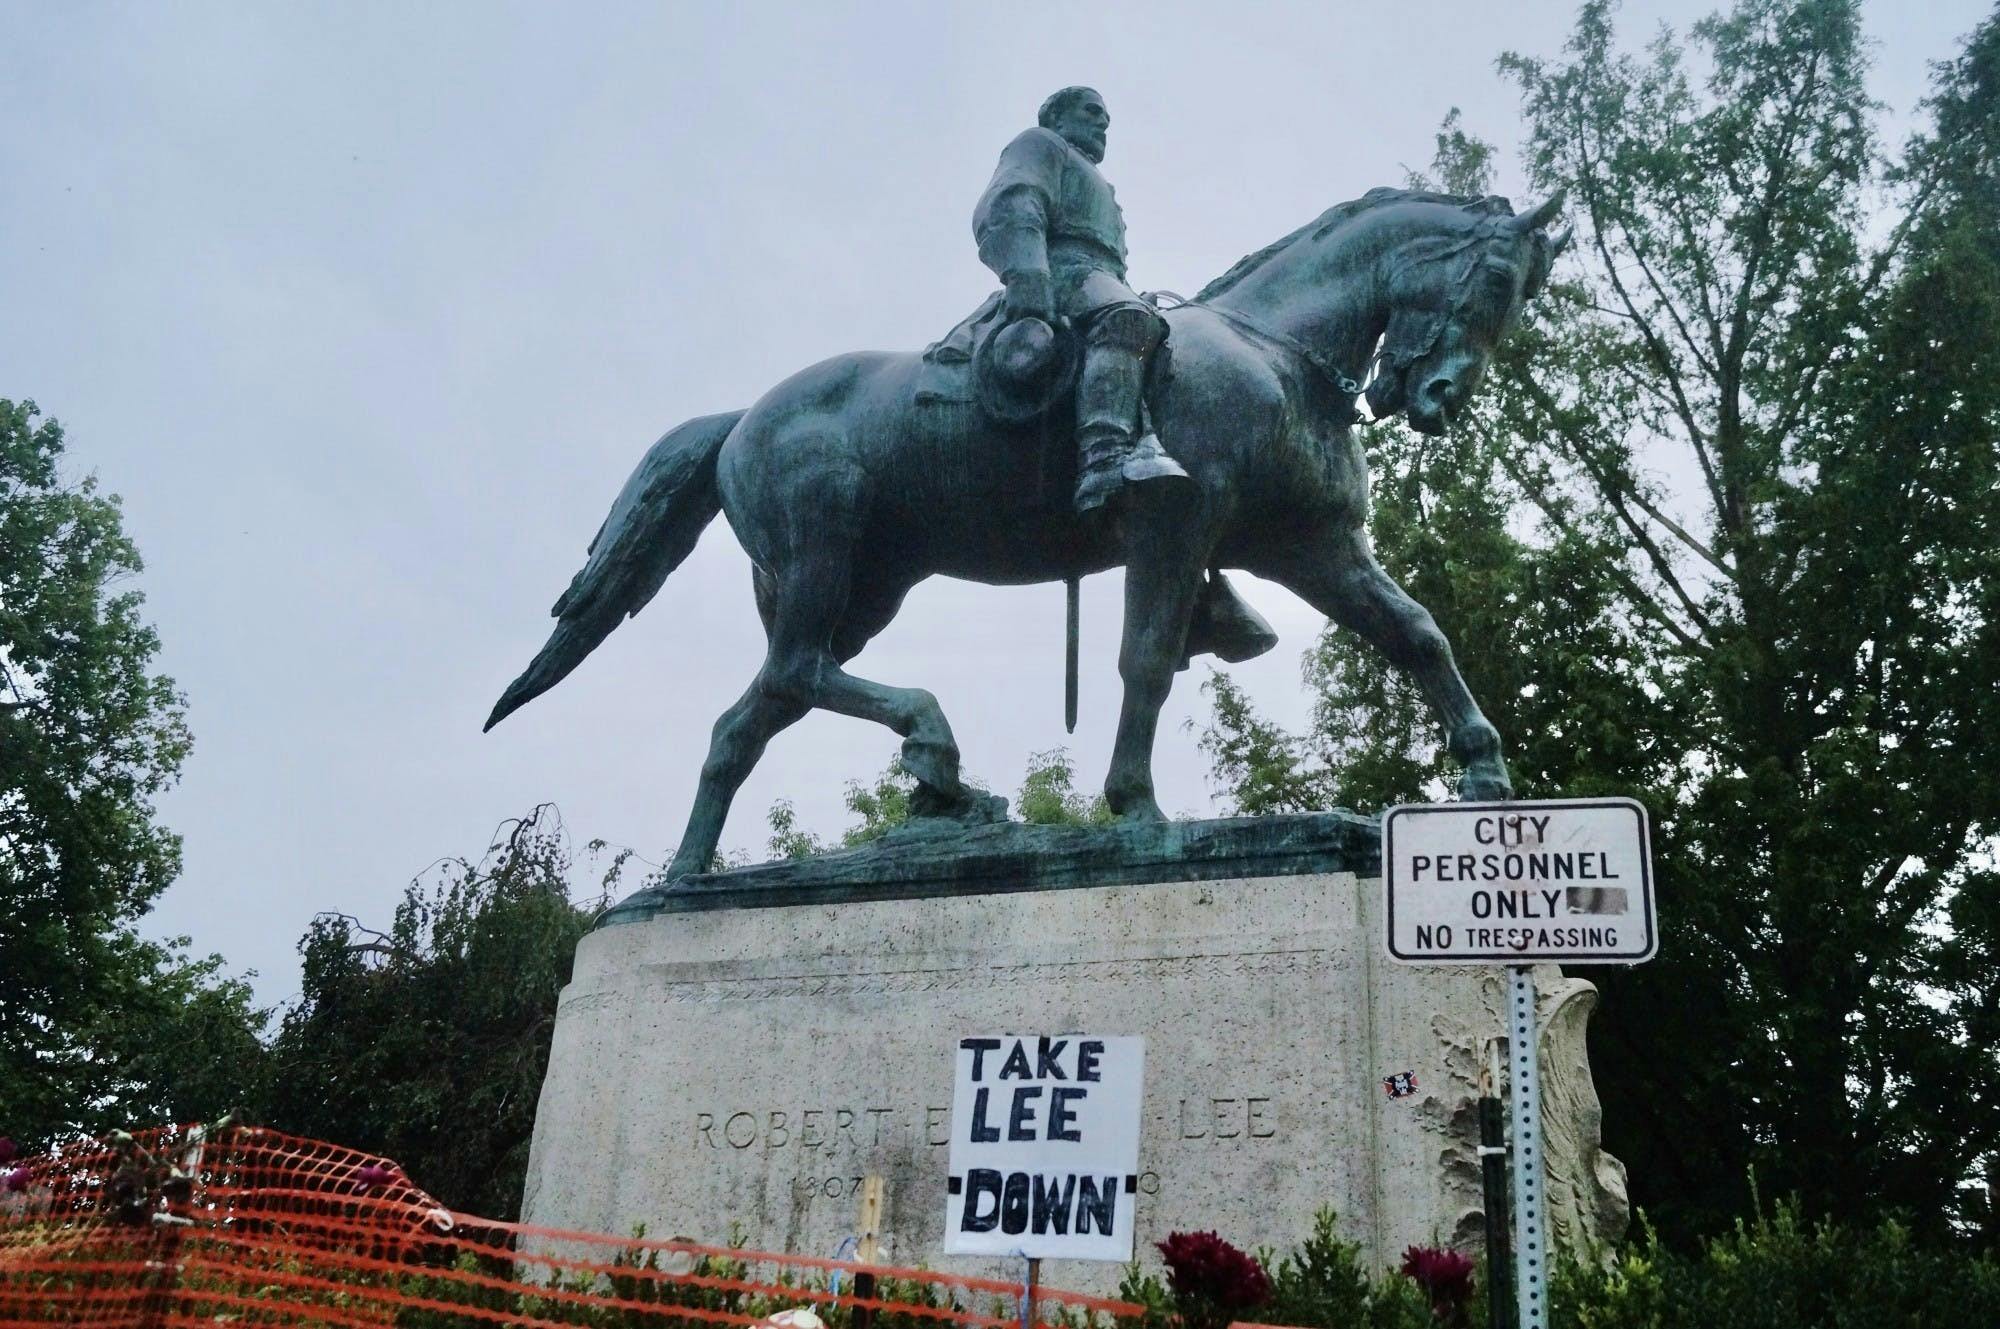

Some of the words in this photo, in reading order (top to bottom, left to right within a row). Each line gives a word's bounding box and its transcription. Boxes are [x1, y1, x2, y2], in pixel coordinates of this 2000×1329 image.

[1474, 815, 1551, 846] CITY
[1411, 851, 1620, 882] PERSONNEL
[1471, 889, 1562, 919] ONLY
[1416, 924, 1452, 949] NO
[1465, 927, 1618, 948] TRESPASSING
[960, 1037, 1105, 1082] TAKE
[694, 1108, 893, 1150] ROBERT
[1178, 1097, 1275, 1140] LEE
[970, 1086, 1088, 1143] LEE
[960, 1168, 1118, 1236] DOWN
